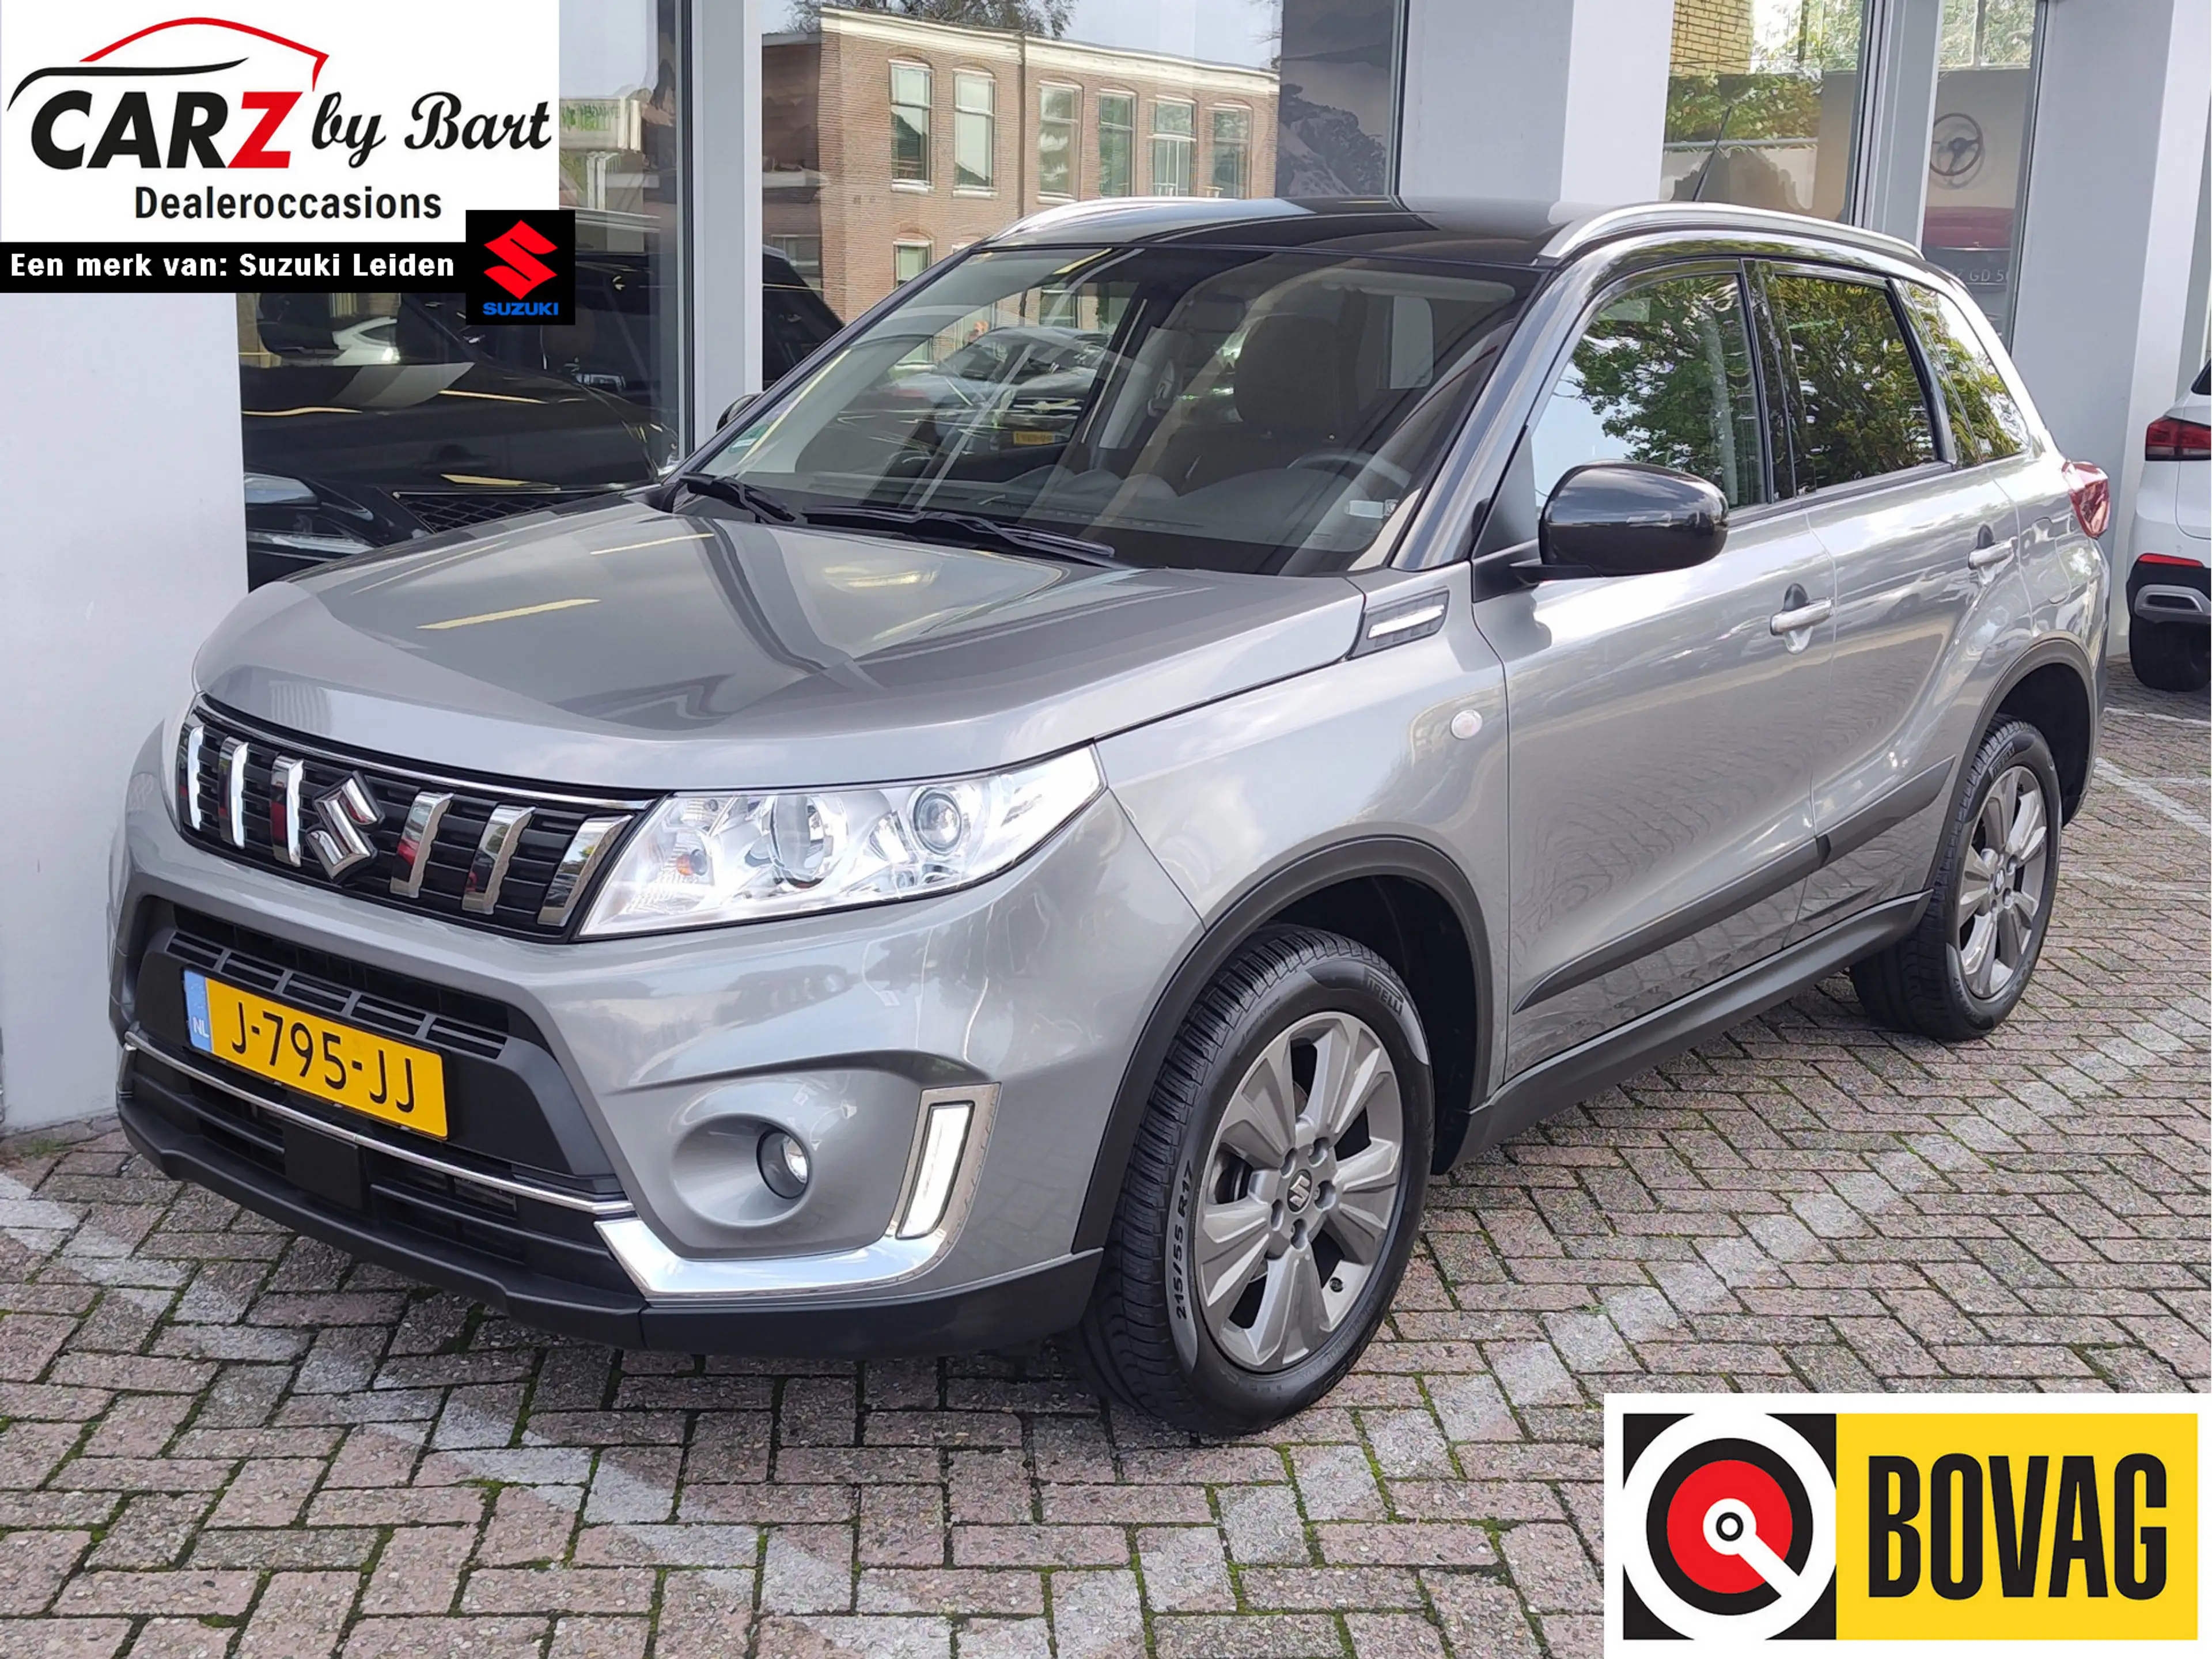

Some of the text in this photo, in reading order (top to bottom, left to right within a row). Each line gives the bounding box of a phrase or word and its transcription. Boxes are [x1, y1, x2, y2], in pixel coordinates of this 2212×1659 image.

[192, 1016, 210, 1039] NL
[231, 1002, 415, 1113] J-795-JJ
[1173, 1160, 1193, 1320] 215/55 R17
